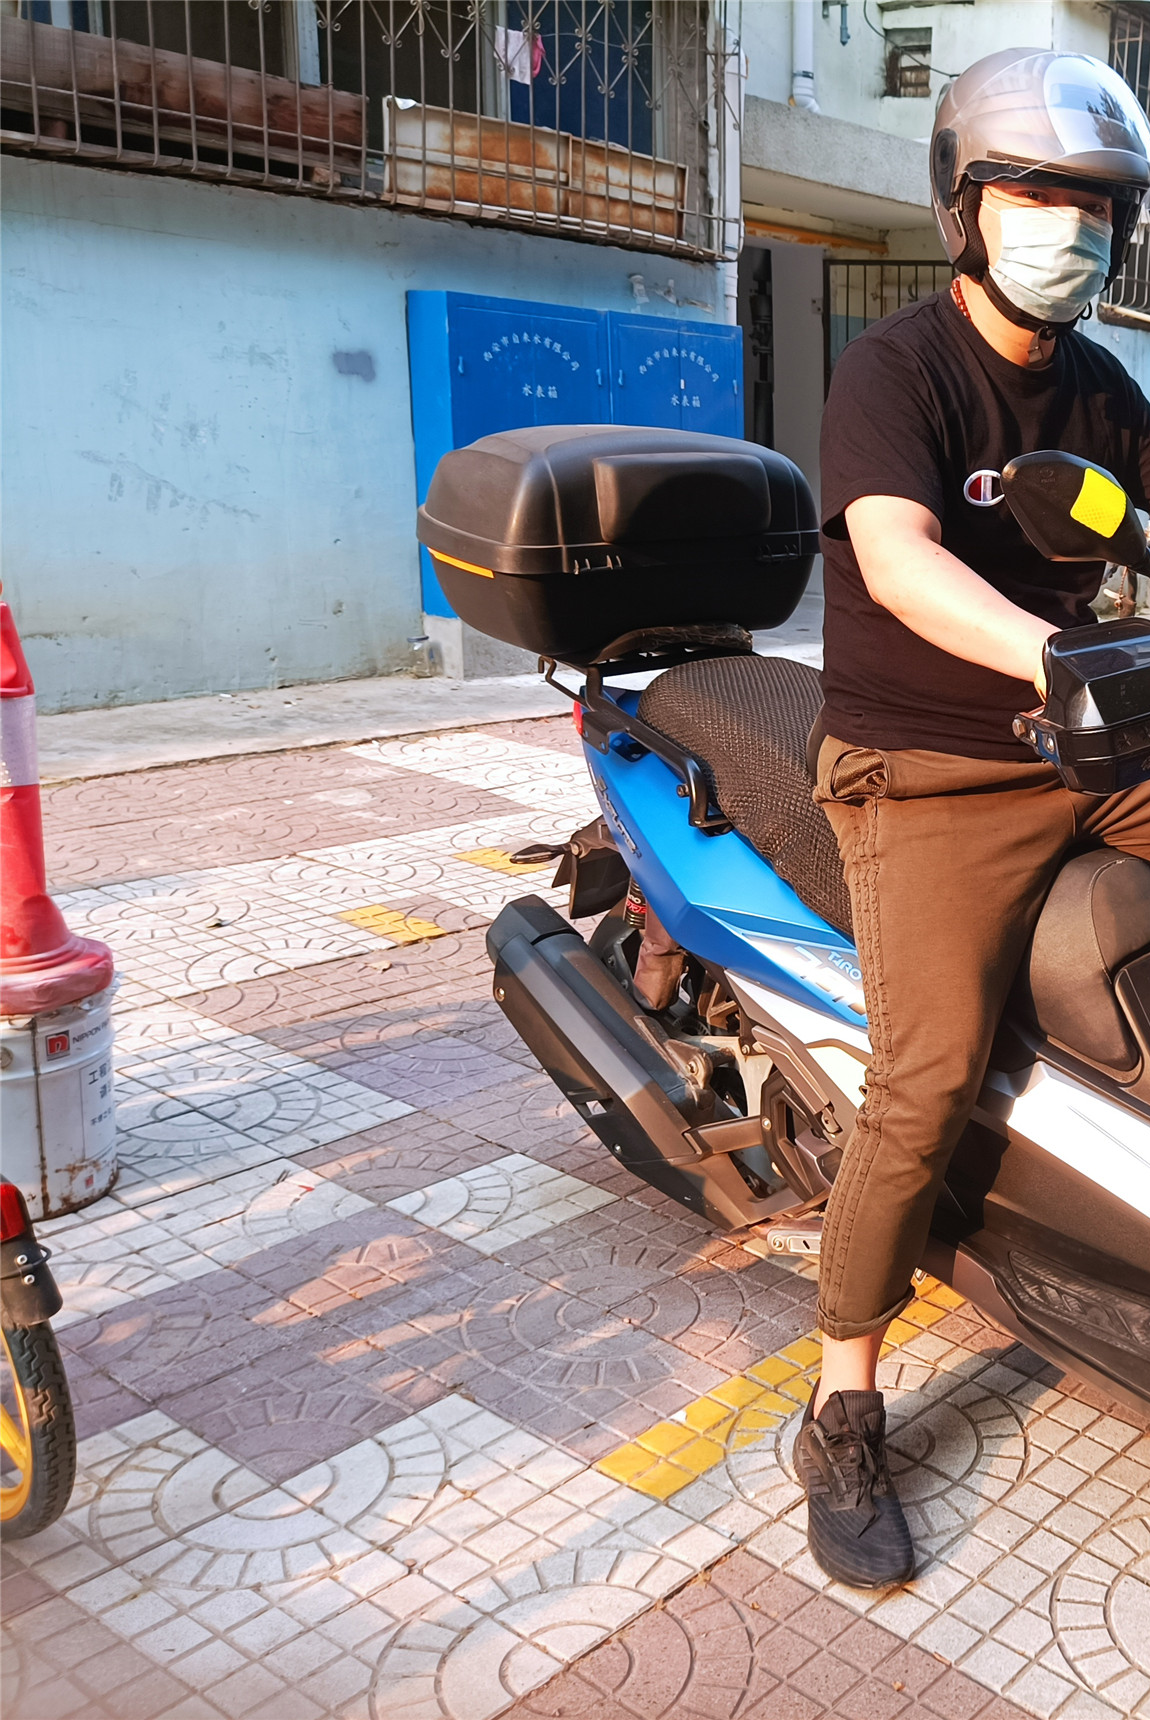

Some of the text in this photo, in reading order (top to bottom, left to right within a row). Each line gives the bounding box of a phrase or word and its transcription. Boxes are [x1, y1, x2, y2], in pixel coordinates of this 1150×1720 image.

[522, 383, 557, 398] 水表箱
[671, 394, 700, 407] 水表箱
[827, 951, 863, 981] TARO
[72, 1026, 101, 1044] NIPPON
